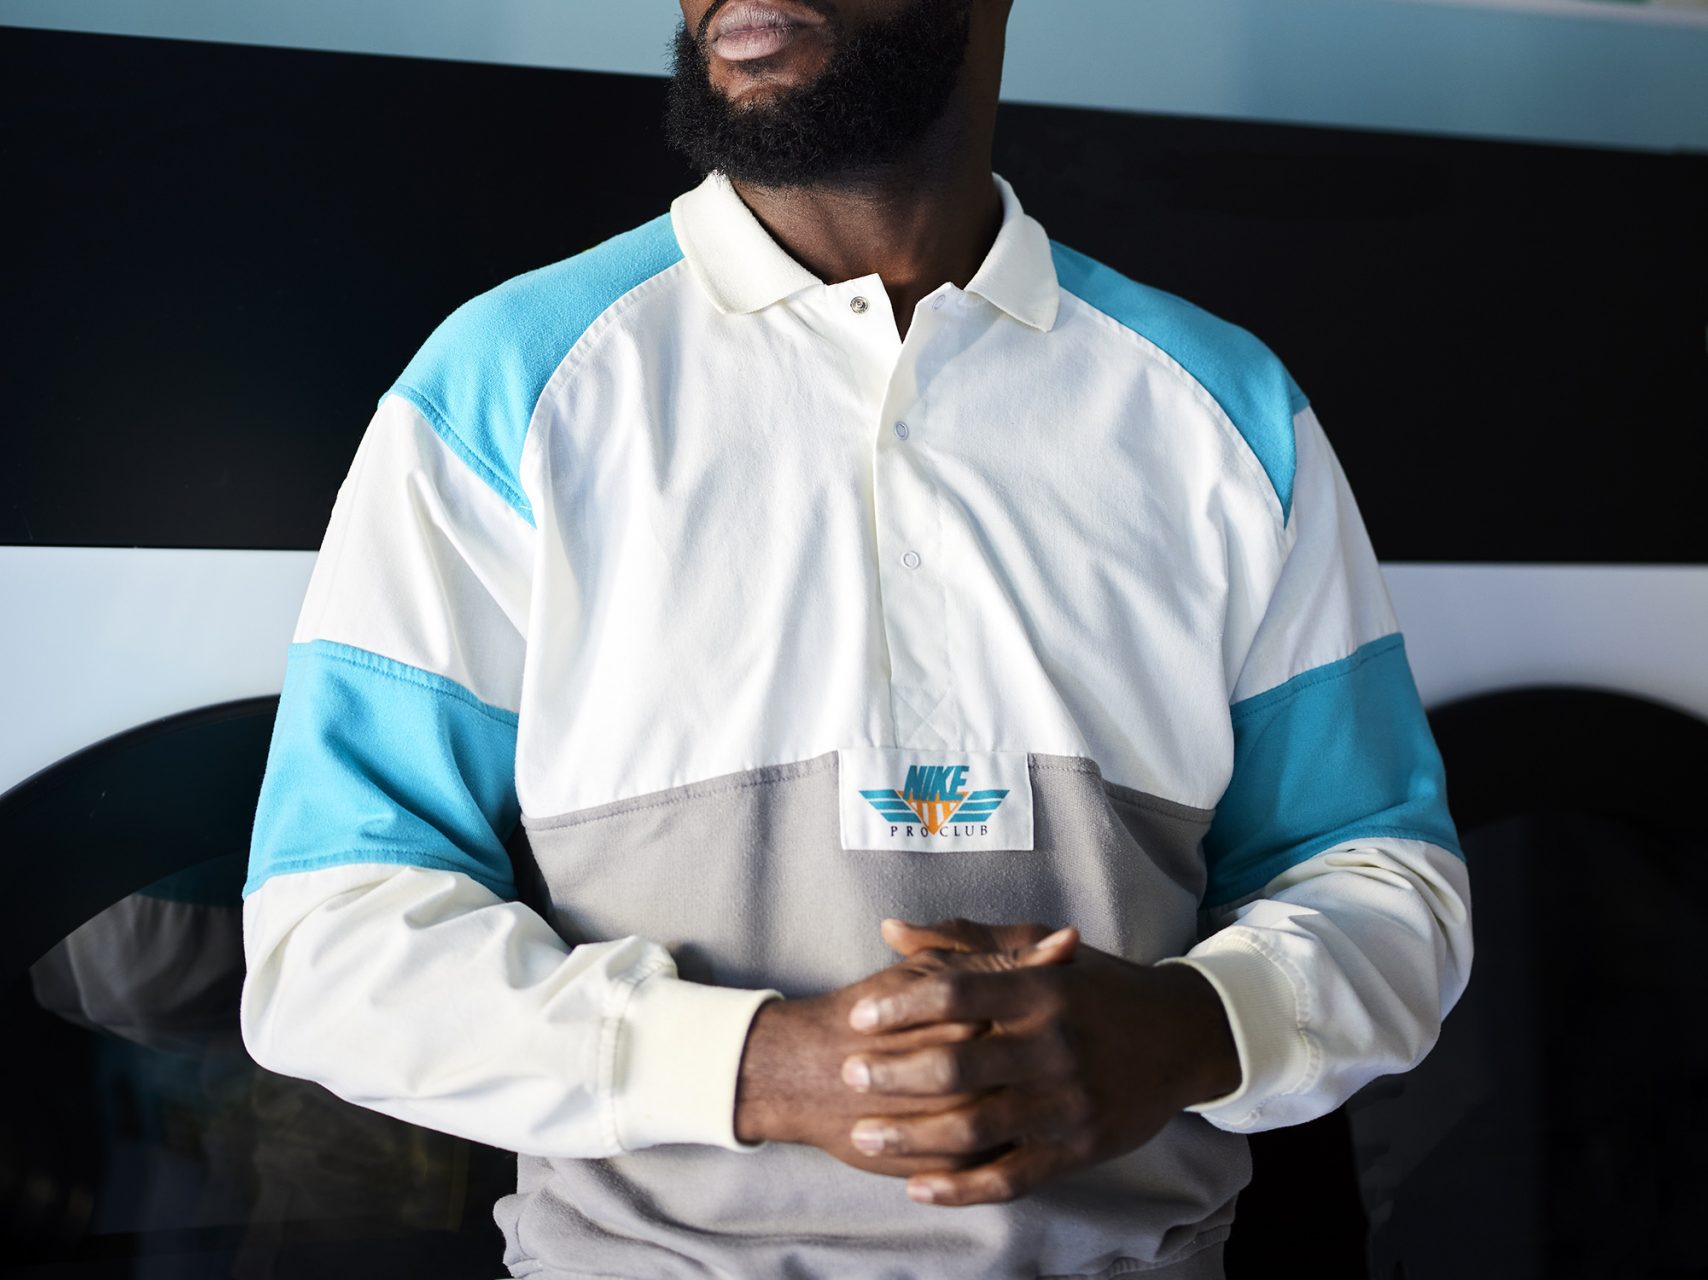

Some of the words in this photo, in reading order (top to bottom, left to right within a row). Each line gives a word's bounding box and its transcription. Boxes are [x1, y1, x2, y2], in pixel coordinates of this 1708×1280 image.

[903, 765, 970, 801] NIKE
[891, 825, 929, 838] PRO
[940, 824, 989, 837] CLUB
